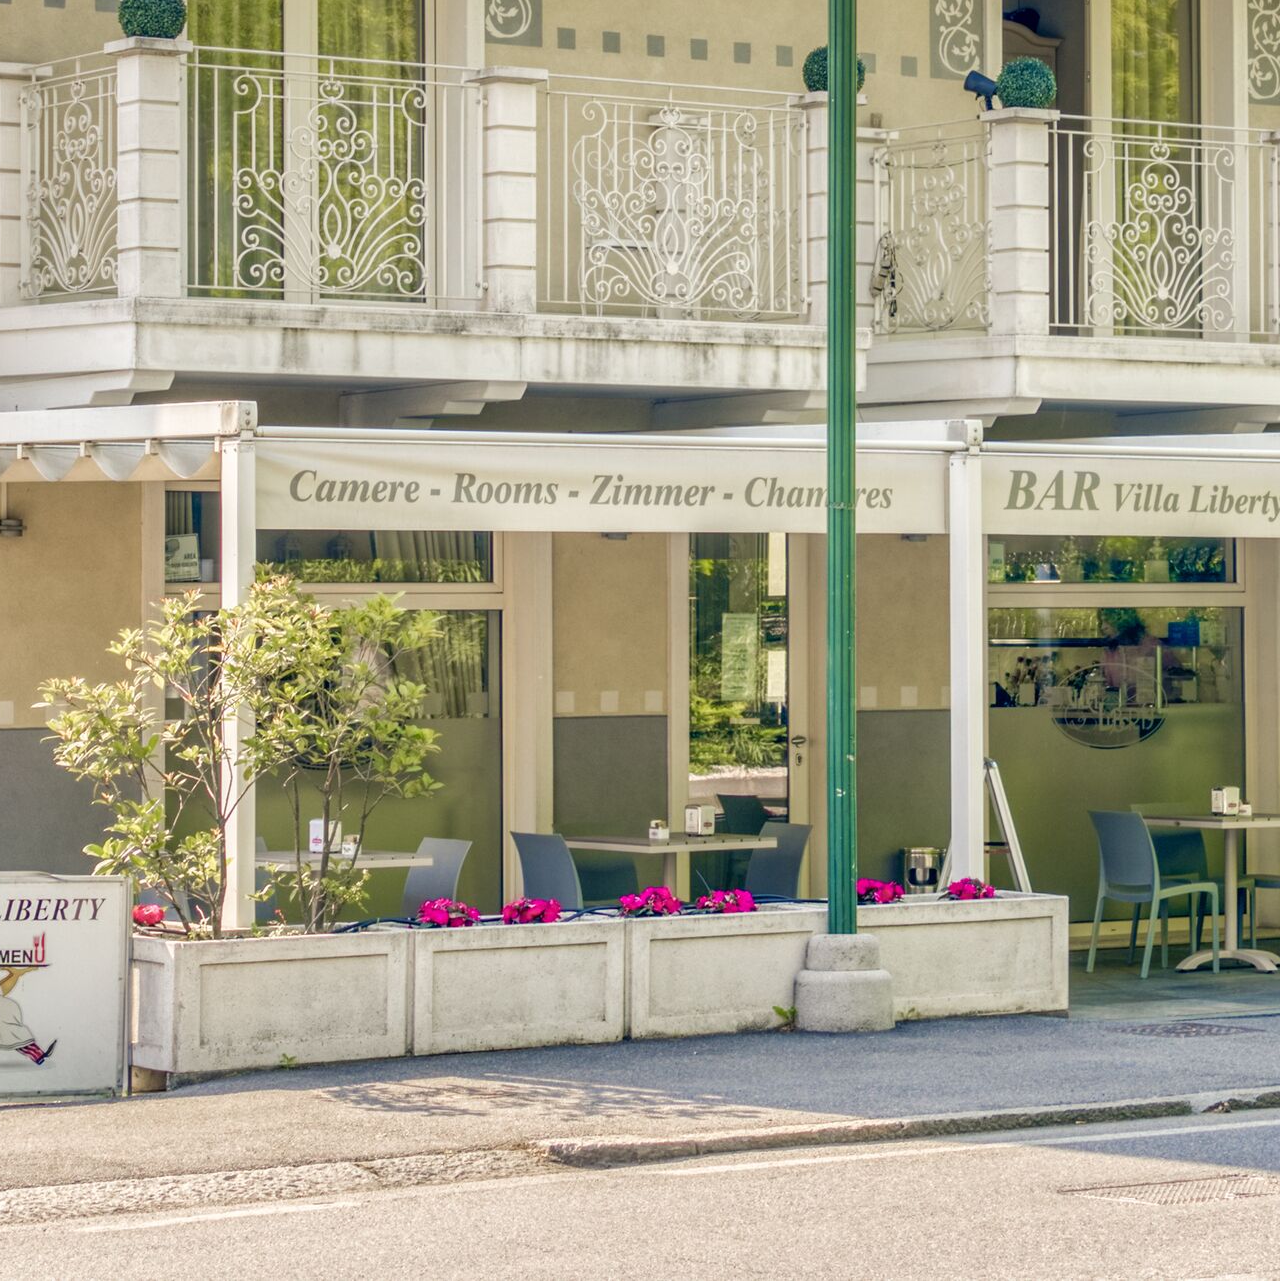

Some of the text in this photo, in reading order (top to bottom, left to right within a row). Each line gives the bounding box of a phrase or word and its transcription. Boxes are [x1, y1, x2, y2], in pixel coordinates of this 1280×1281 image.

[289, 469, 421, 505] Camere
[451, 473, 559, 506] Rooms
[590, 474, 716, 508] Zimmer
[1004, 470, 1102, 512] BAR
[1113, 482, 1180, 514] Villa
